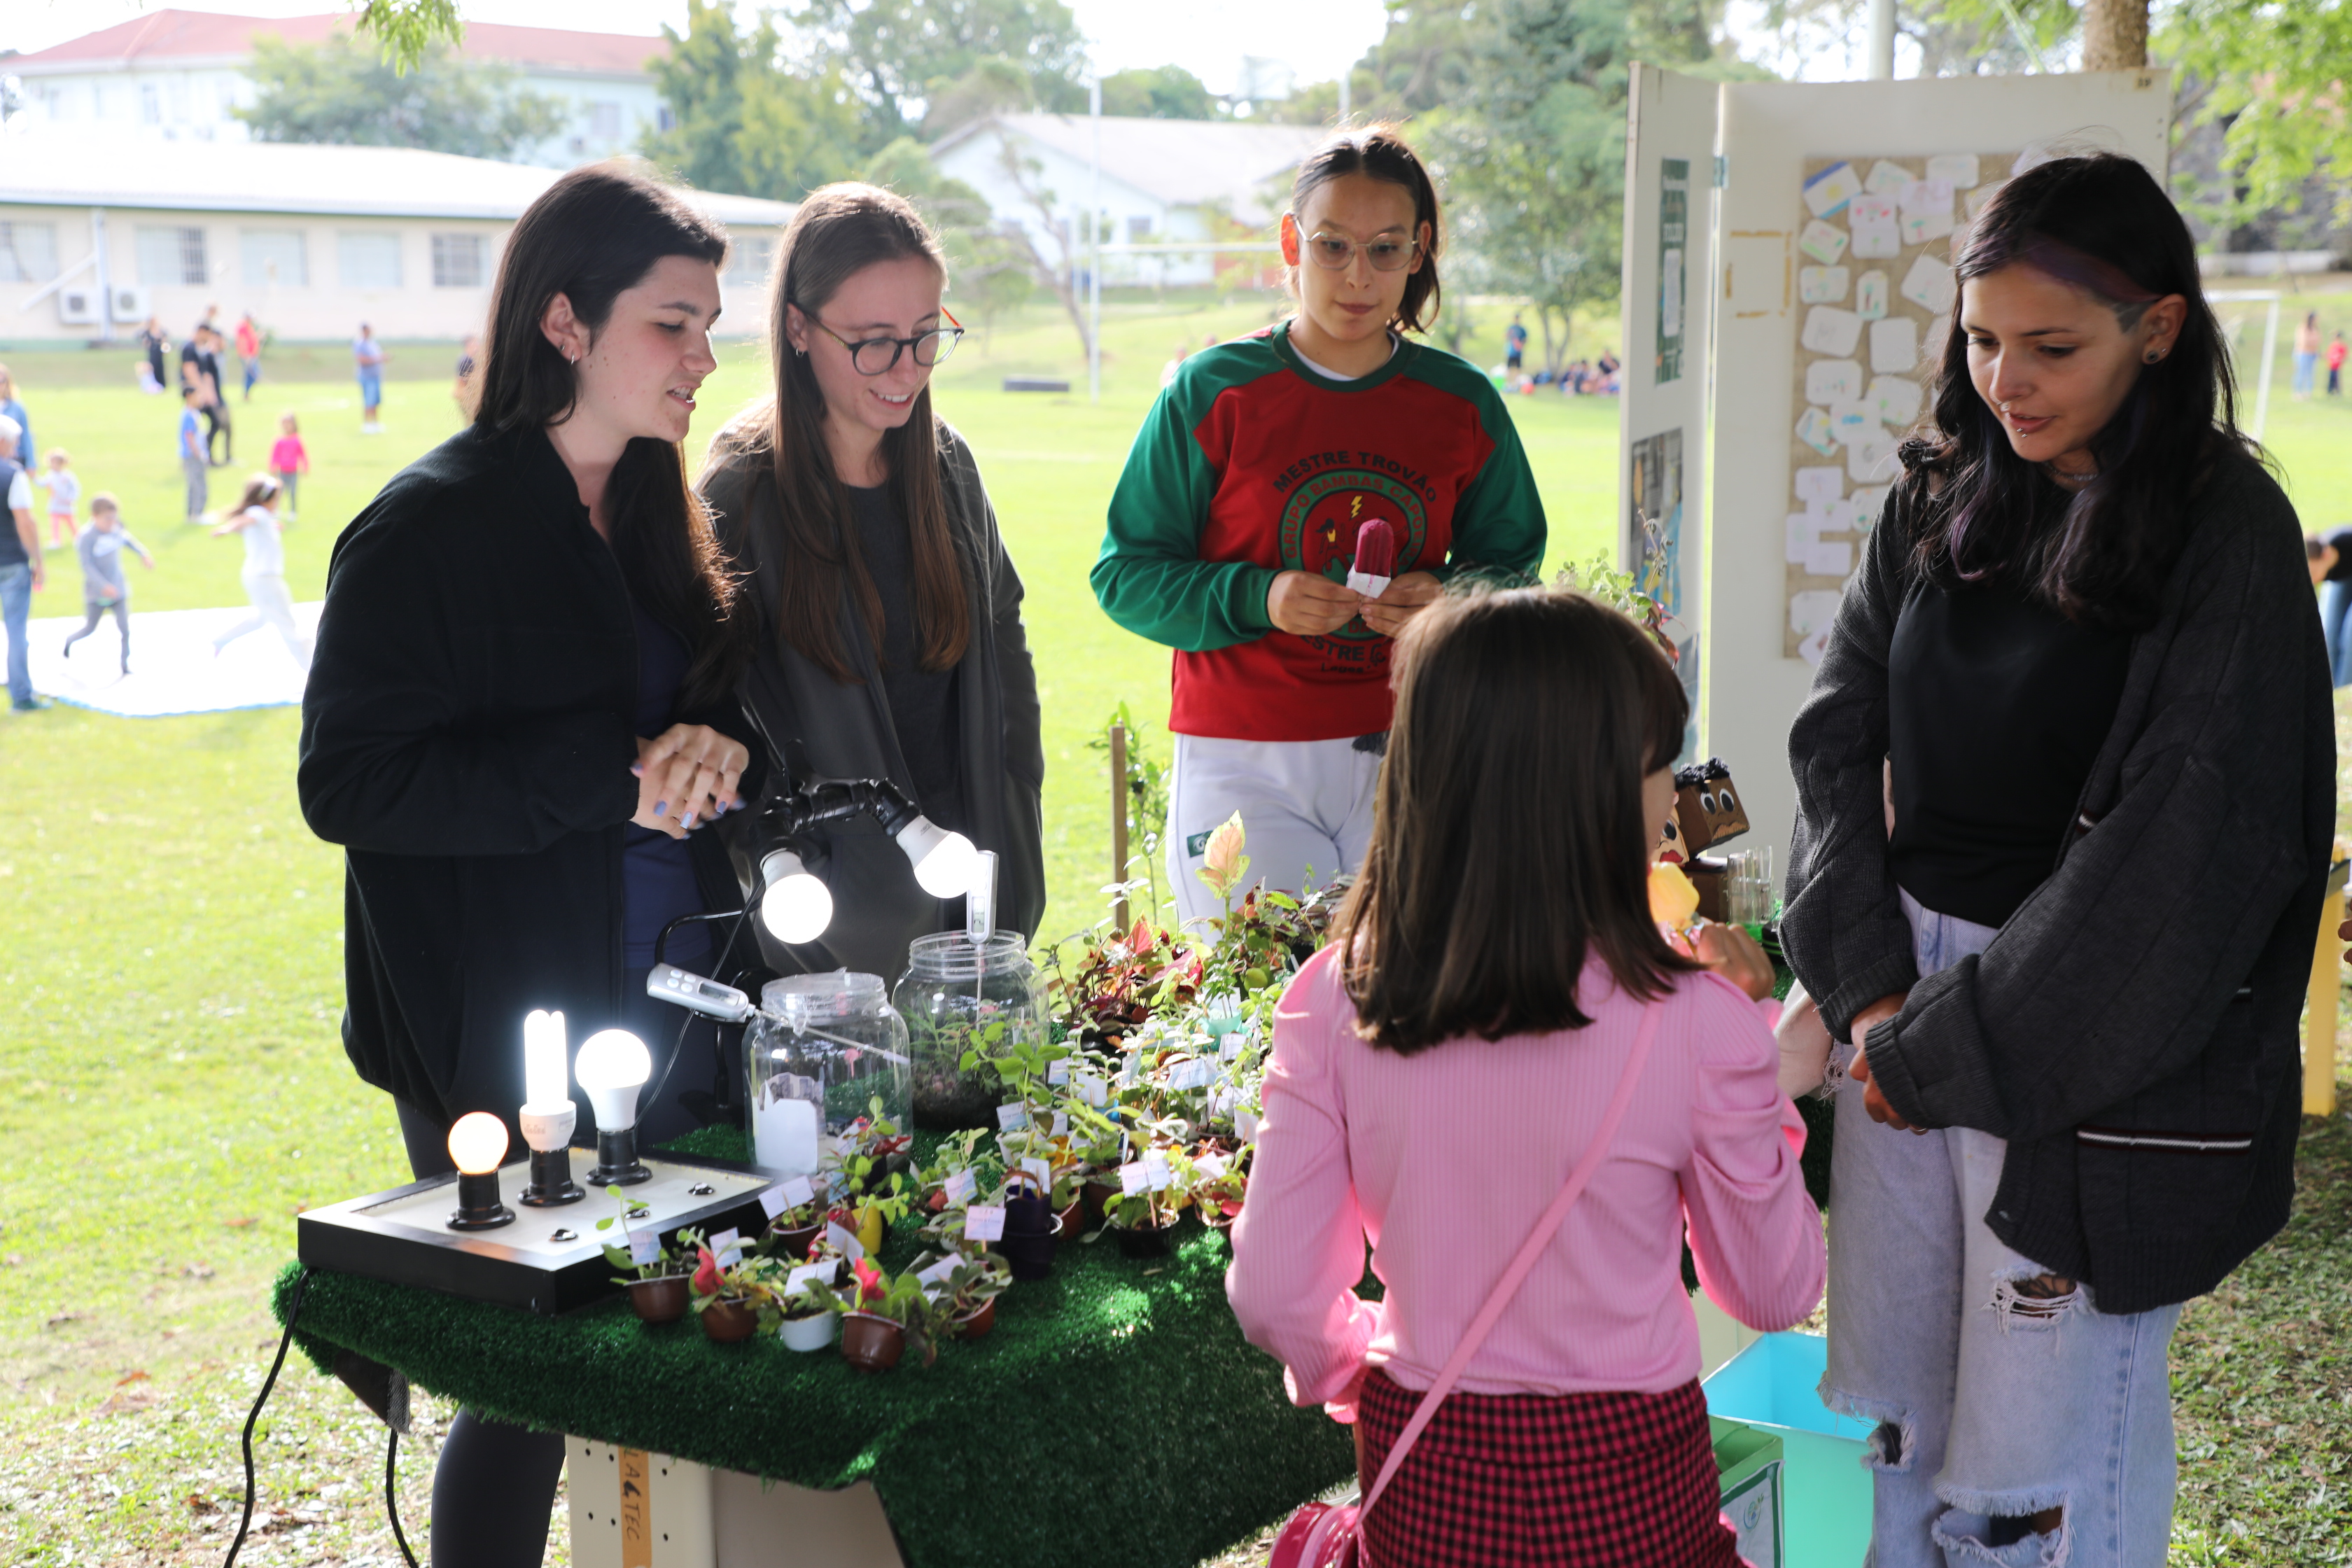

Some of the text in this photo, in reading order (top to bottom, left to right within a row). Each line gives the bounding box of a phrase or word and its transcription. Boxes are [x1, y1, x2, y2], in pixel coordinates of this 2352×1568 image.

[1273, 451, 1436, 503] MESTRE TROVÃO
[1284, 475, 1423, 566] GRUPO BAMBAS CAPOEIRA
